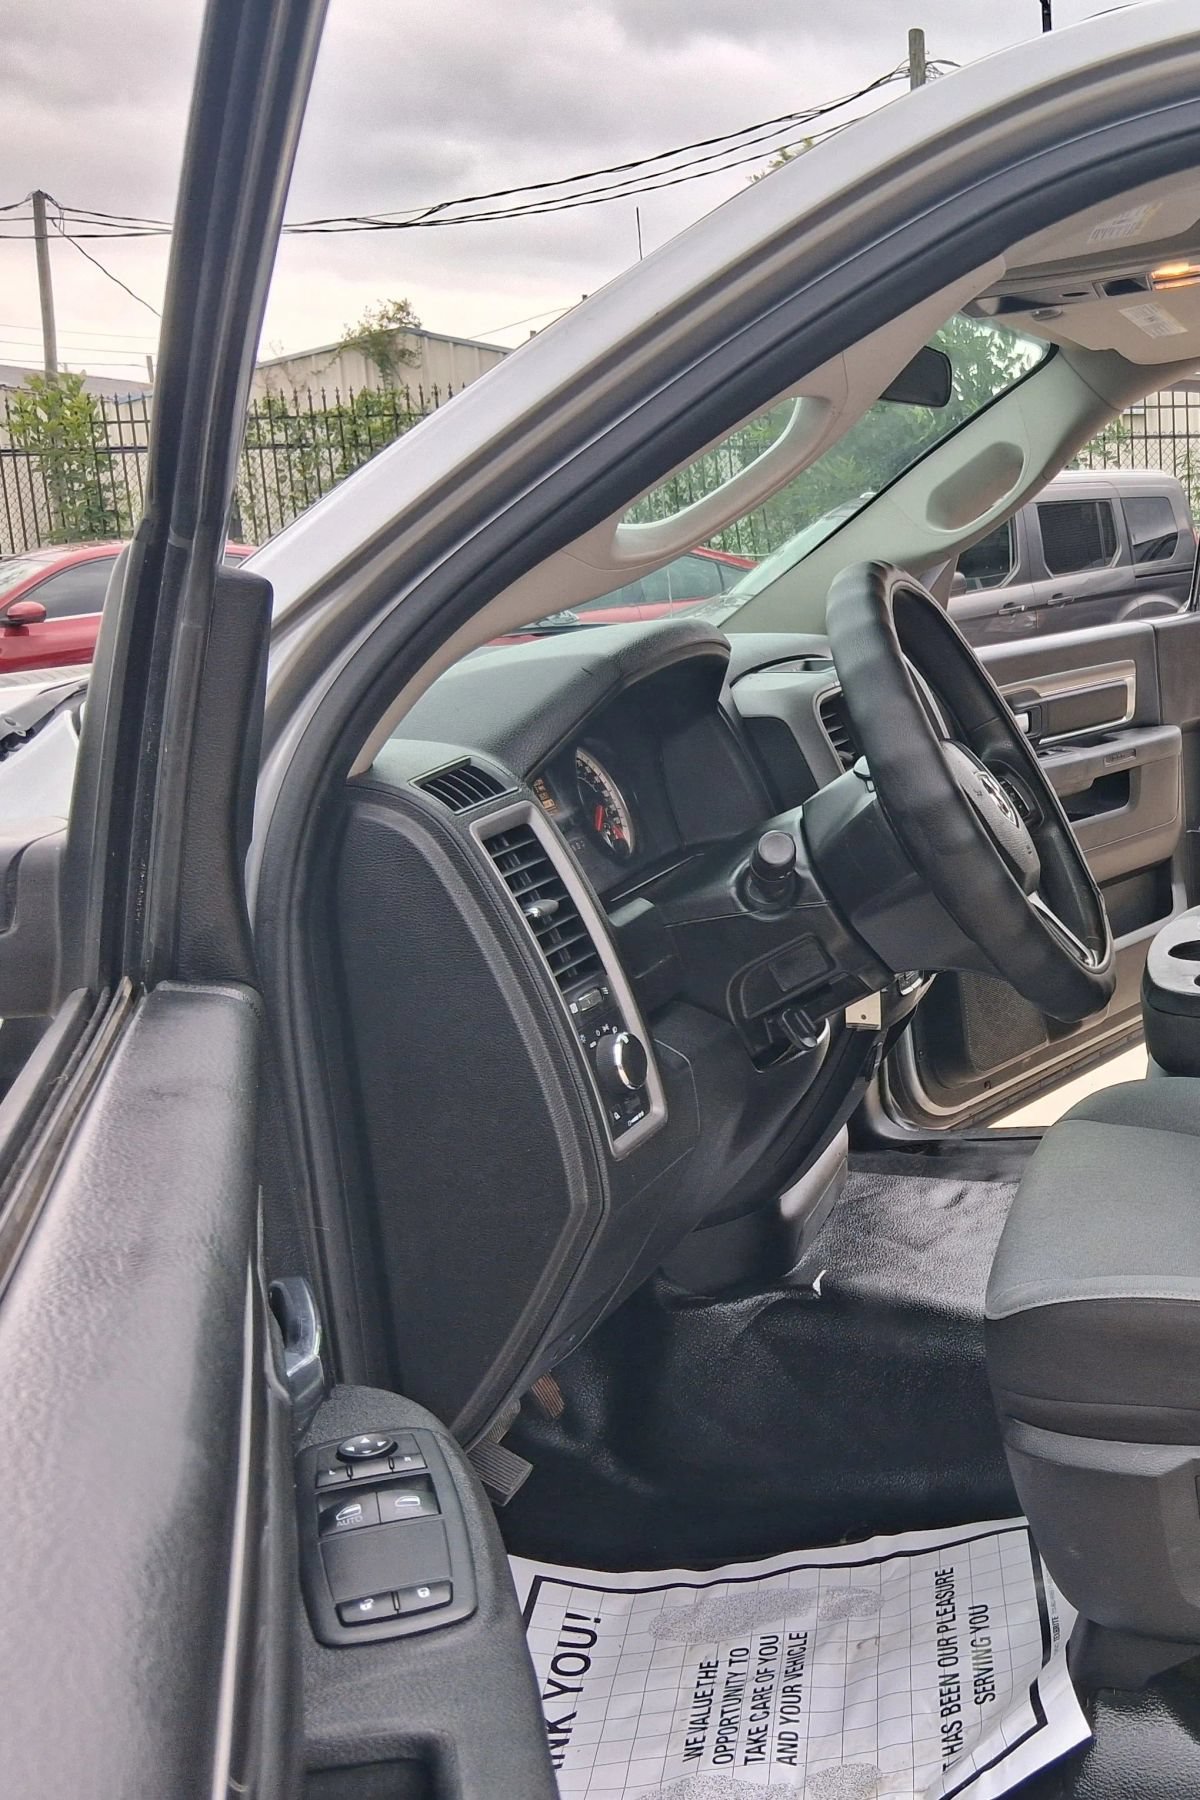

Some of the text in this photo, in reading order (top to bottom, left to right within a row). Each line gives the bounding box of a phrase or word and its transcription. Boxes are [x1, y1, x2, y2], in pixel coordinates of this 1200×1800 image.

[336, 1515, 364, 1527] AUTO
[934, 1566, 957, 1634] PLEASURE
[542, 1612, 602, 1700] YOU!
[937, 1635, 959, 1668] OUR
[938, 1672, 961, 1718] BEEN
[968, 1604, 996, 1706] SERVING YOU
[682, 1660, 719, 1762] WE VALUE THE
[712, 1647, 750, 1765] OPPORTUNITY TO
[744, 1635, 779, 1766] TAKE CARE OF YOU
[776, 1631, 808, 1766] AND YOUR VEHICLE
[940, 1719, 963, 1757] HAS
